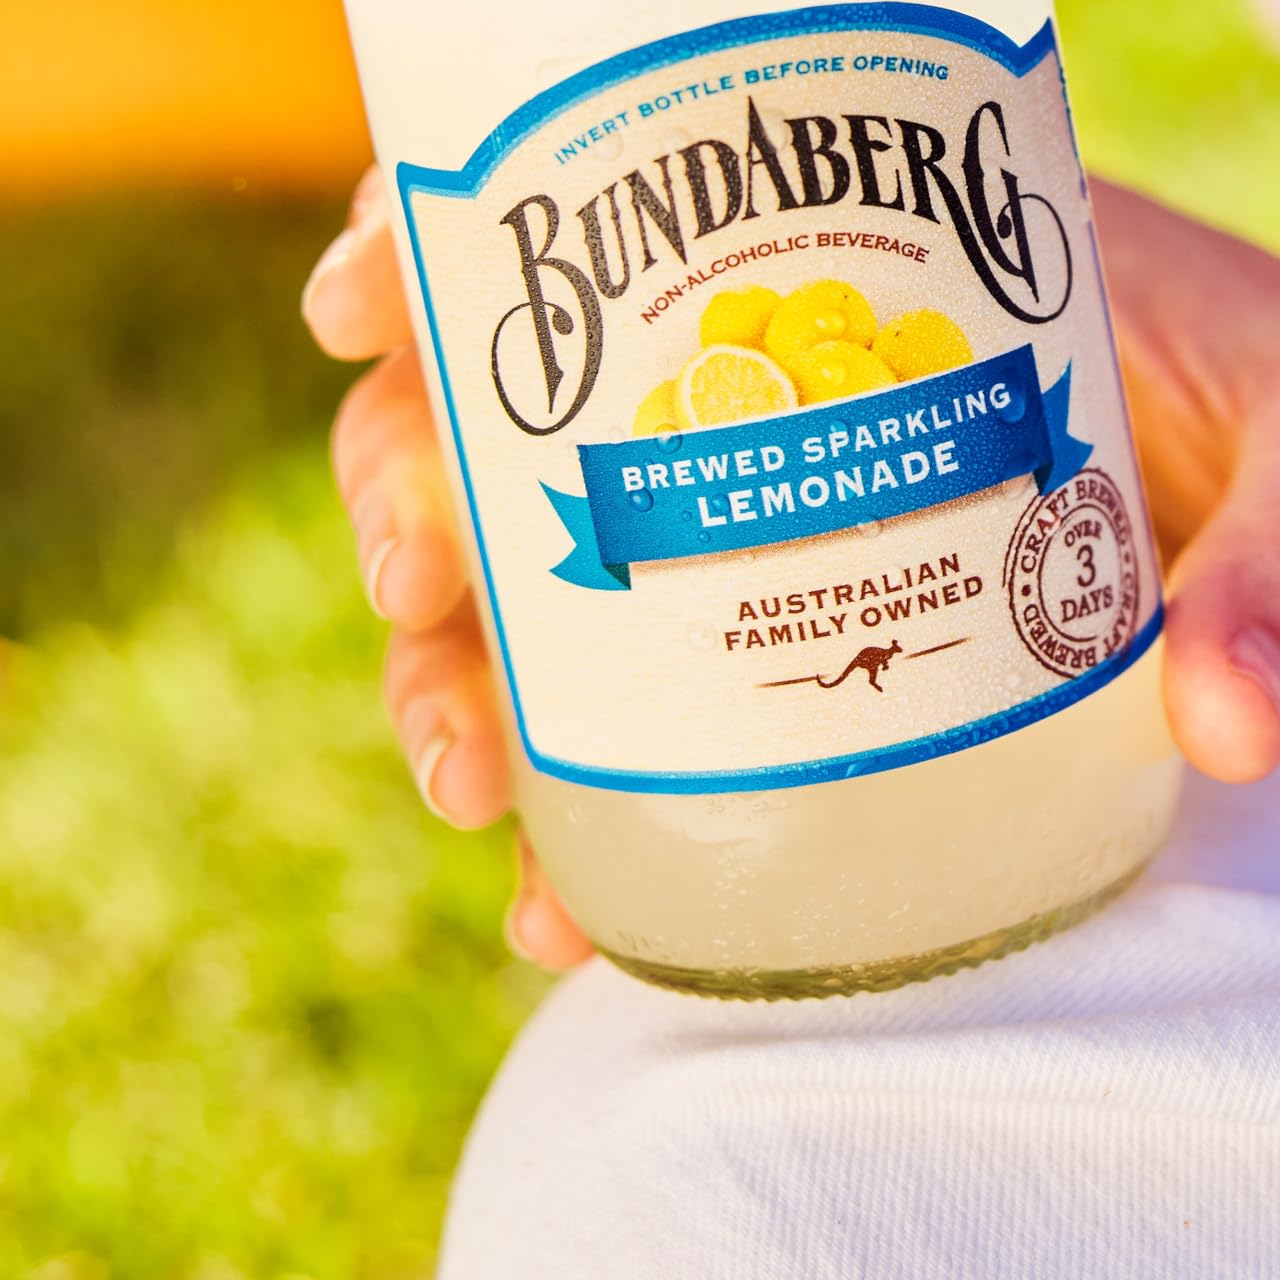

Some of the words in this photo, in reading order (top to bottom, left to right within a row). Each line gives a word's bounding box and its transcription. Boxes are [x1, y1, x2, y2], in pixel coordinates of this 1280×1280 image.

[554, 110, 630, 166] INVERT
[637, 74, 736, 119] BOTTLE
[744, 55, 845, 83] BEFORE
[853, 55, 950, 81] OPENING
[490, 94, 1074, 437] BUNDABERG
[640, 233, 809, 324] NON-ALCOHOLIC
[817, 231, 931, 265] BEVERAGE
[621, 445, 786, 493] BREWED
[801, 382, 1012, 464] SPARKLING
[697, 440, 960, 528] LEMONADE
[1020, 487, 1069, 574] CRAFT
[1064, 519, 1102, 548] OVER
[1076, 543, 1097, 588] 3
[723, 612, 848, 652] FAMILY
[860, 575, 984, 628] OWNED
[738, 552, 961, 623] AUSTRALIAN
[1060, 584, 1114, 623] DAYS
[1022, 603, 1098, 669] BREWED
